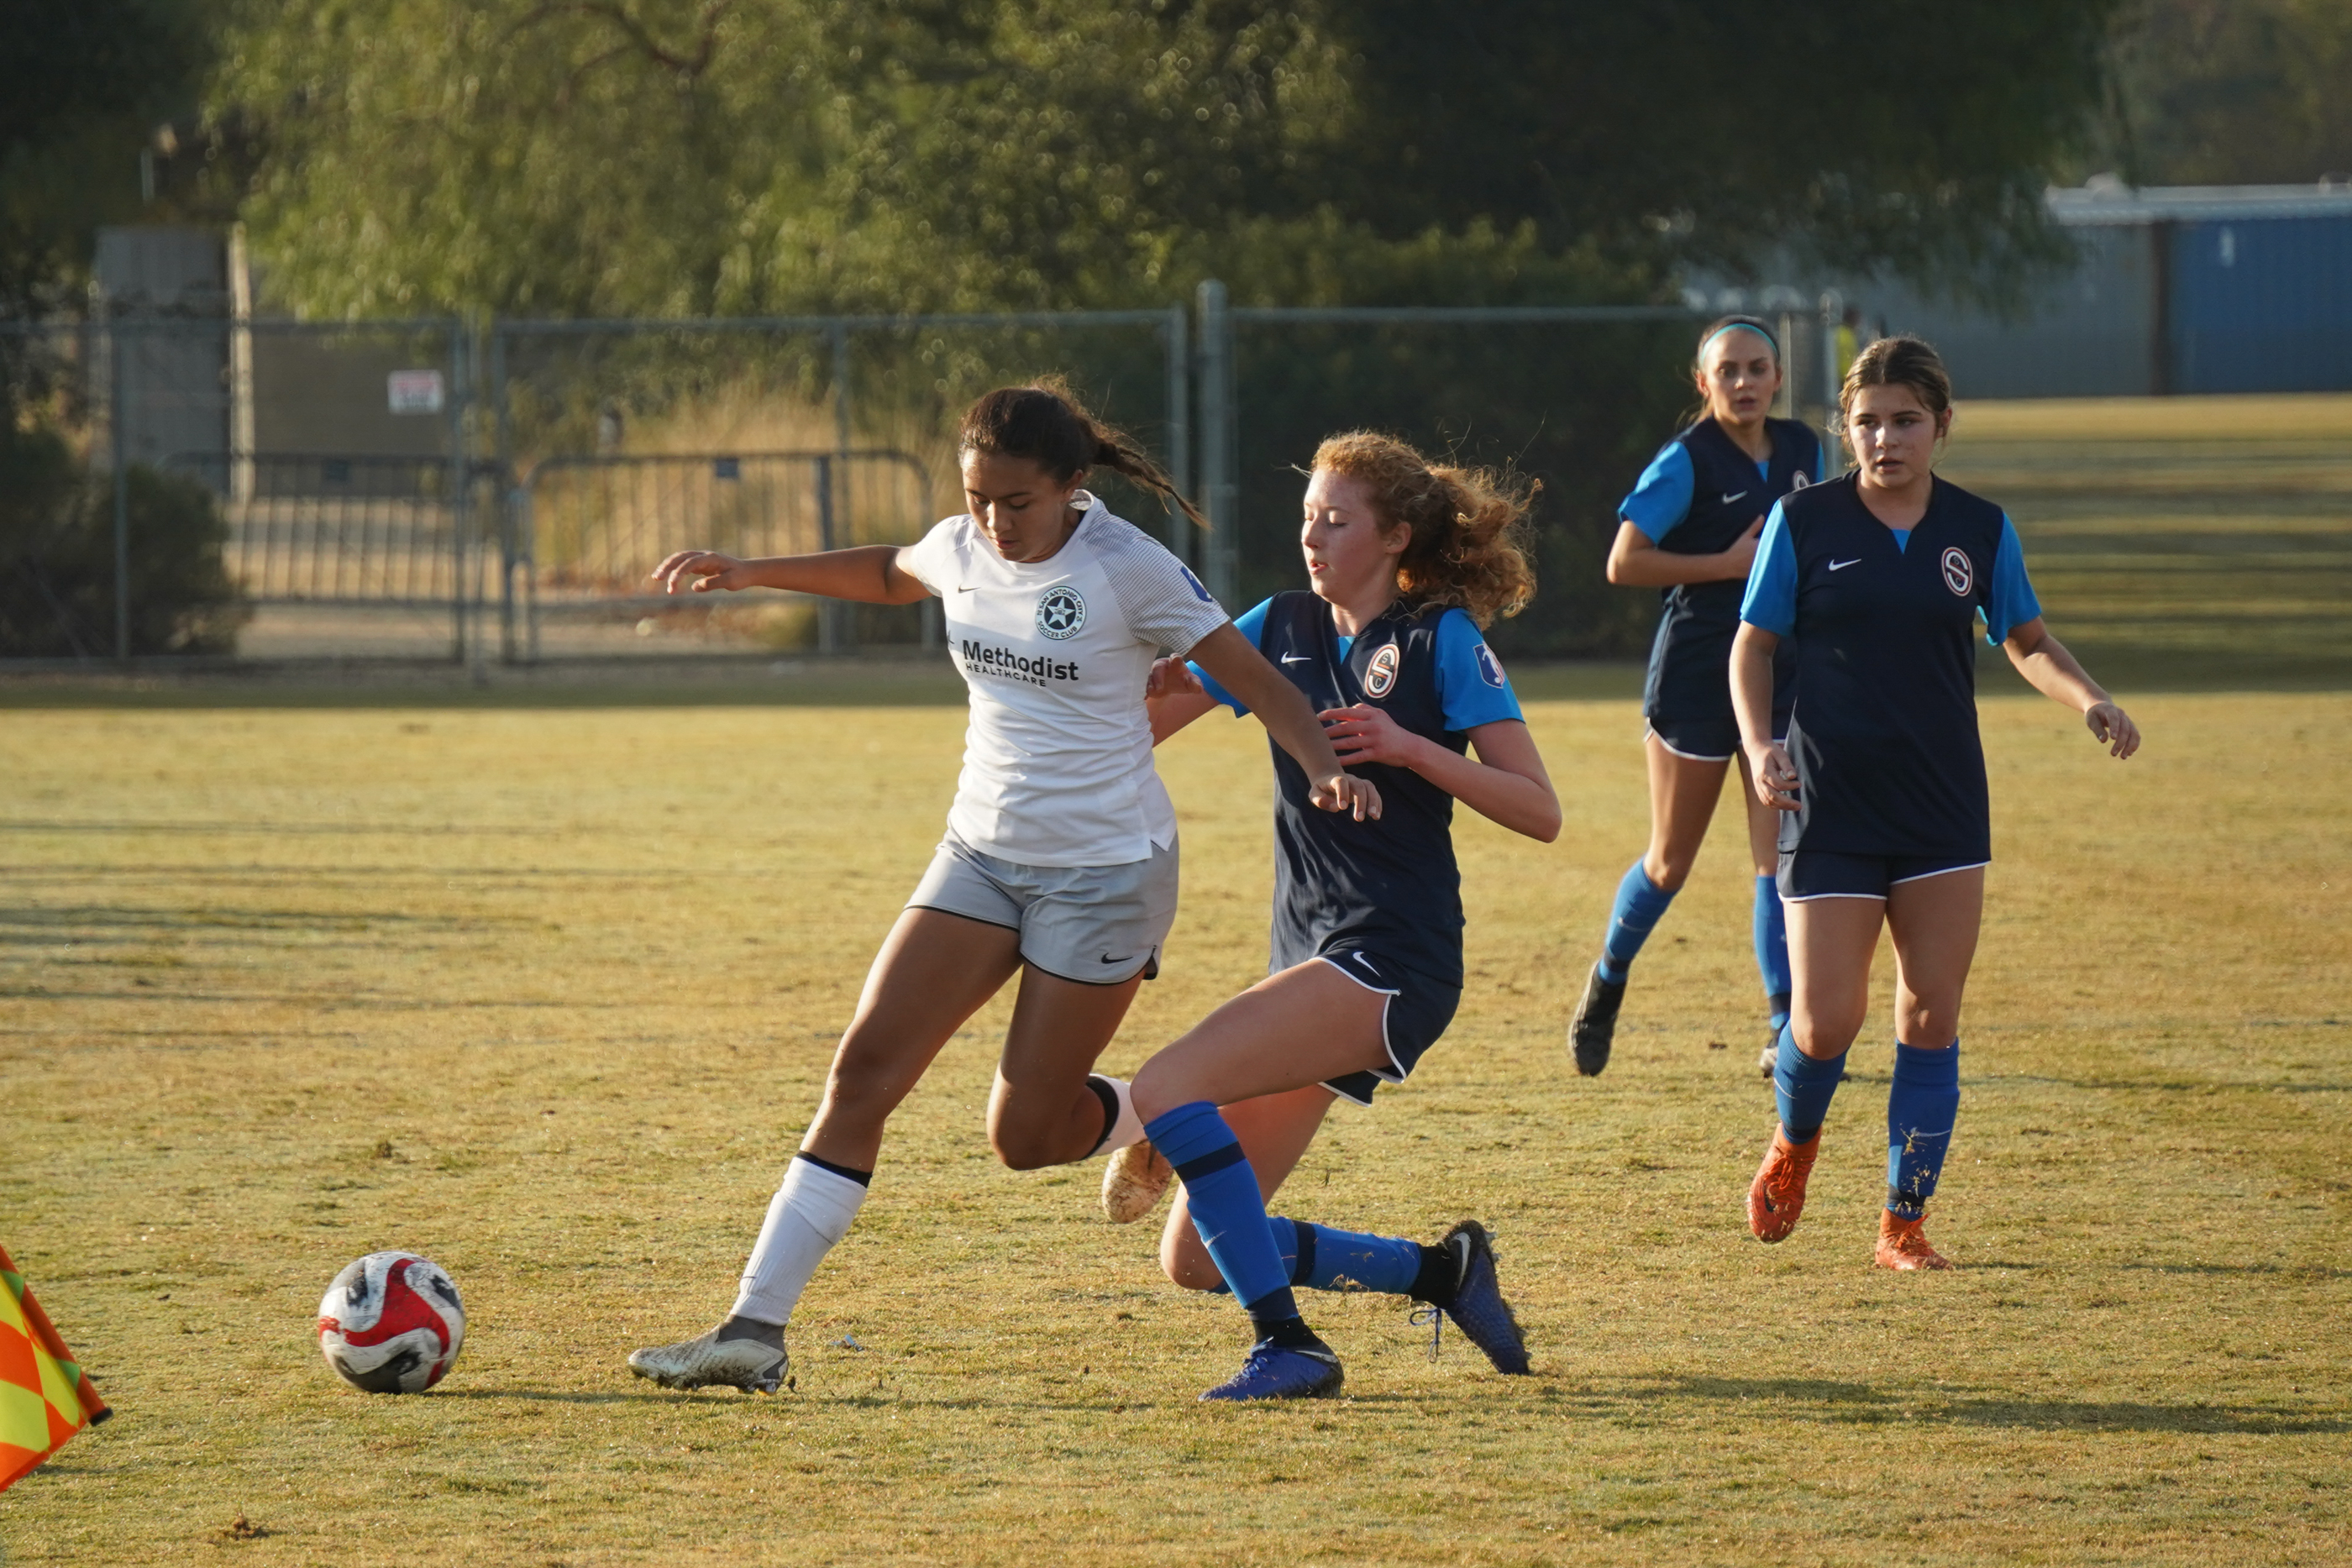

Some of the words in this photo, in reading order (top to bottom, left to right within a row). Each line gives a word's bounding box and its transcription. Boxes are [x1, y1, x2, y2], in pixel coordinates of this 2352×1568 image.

[1039, 595, 1049, 608] SAN
[1049, 589, 1078, 600] ANTONIO
[1037, 621, 1059, 637] SOCCER
[1060, 626, 1078, 637] CLUB
[963, 639, 1079, 681] Methodist
[1382, 653, 1389, 663] S
[966, 663, 1047, 687] HEALTHCARE
[1375, 677, 1382, 688] C
